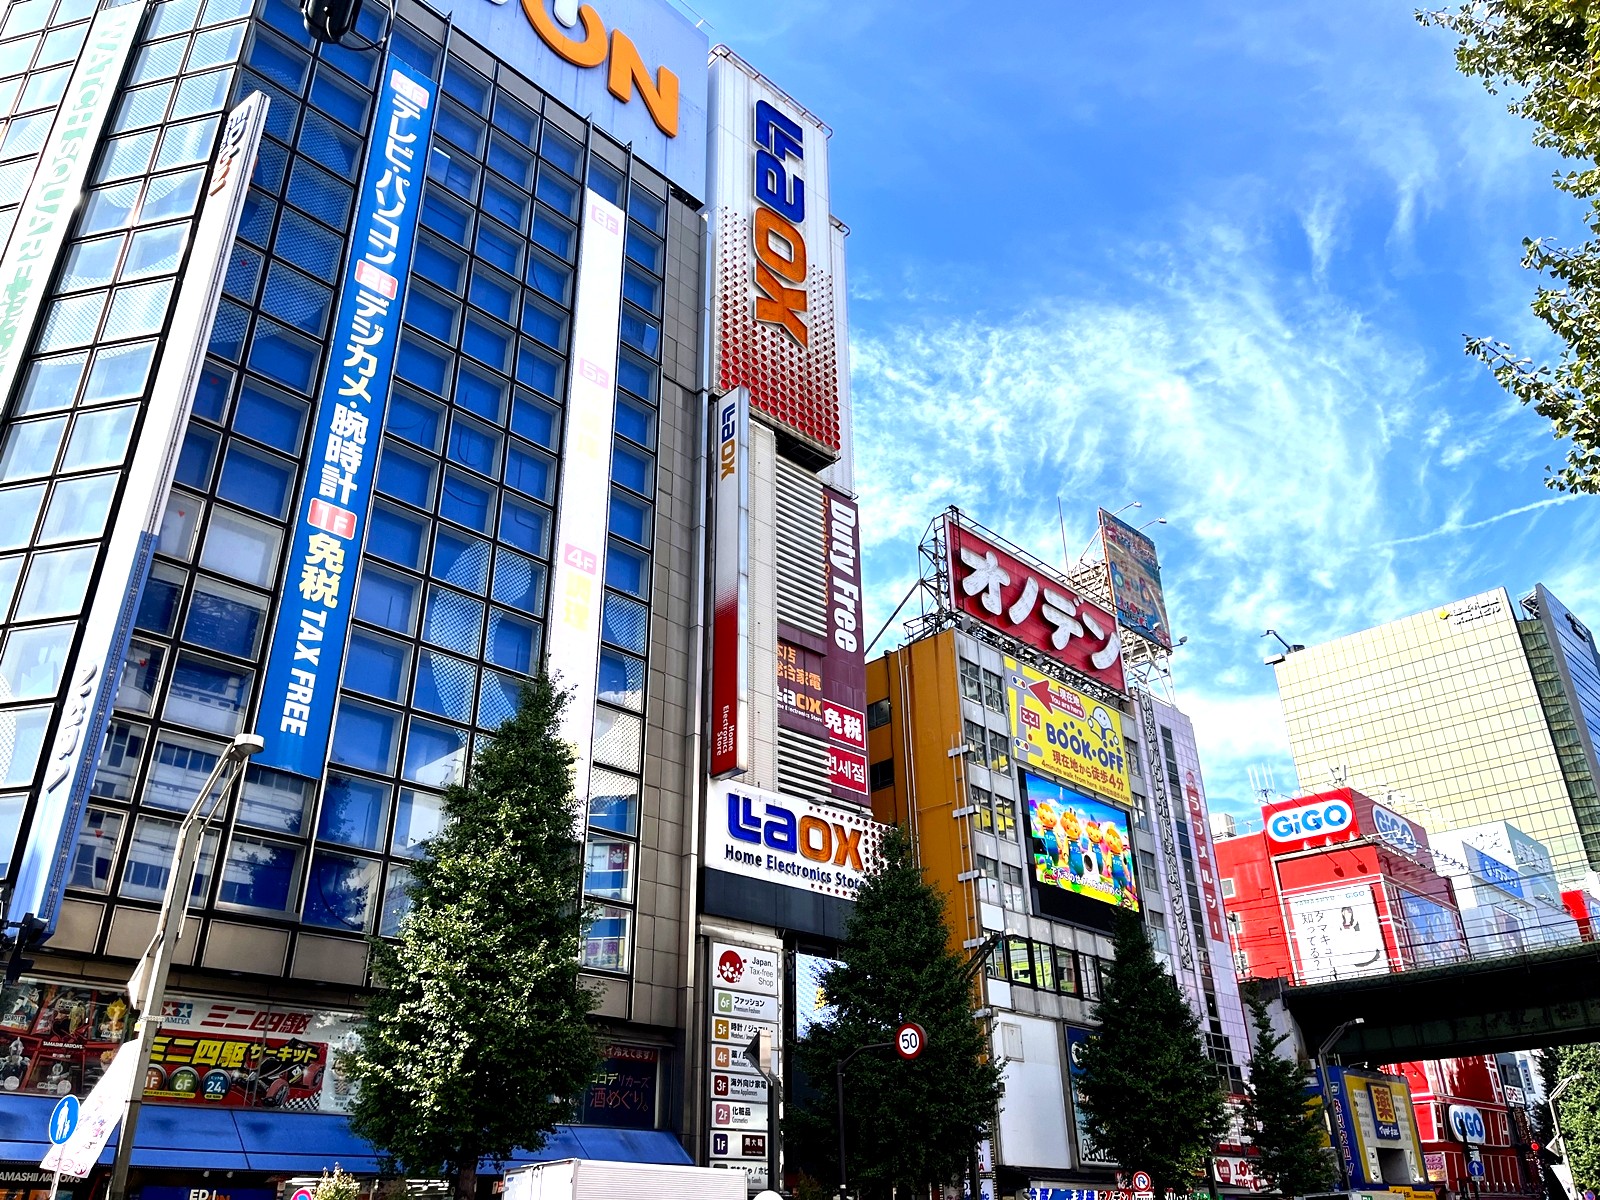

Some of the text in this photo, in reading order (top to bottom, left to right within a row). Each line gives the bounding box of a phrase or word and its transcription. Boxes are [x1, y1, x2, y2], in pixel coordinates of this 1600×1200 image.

[366, 92, 421, 265] テレビ・パソコン
[319, 290, 390, 505] デジカメ・腕時計
[314, 504, 350, 536] 1F
[299, 532, 346, 609] 免税
[566, 545, 595, 572] 4F
[830, 498, 859, 653] Duty Free
[960, 547, 1120, 670] オノデン
[280, 608, 327, 737] TAX FREE
[1021, 709, 1039, 726] ここ!
[1051, 695, 1084, 717] You are here
[722, 704, 730, 754] Electronics
[824, 707, 862, 742] 免税
[1052, 750, 1124, 792] 現在地から徒歩4分
[1271, 804, 1349, 835] GiGO
[725, 844, 762, 867] Home
[767, 854, 832, 884] Electronics
[1189, 795, 1219, 935] ラブメルシー
[750, 966, 774, 978] Tax-free
[758, 977, 774, 988] Shop
[720, 997, 730, 1008] 6F
[734, 996, 765, 1007] ファッション
[162, 1016, 190, 1025] AMIYA
[200, 1004, 314, 1035] ミニ四駆
[717, 1024, 727, 1035] 5F
[902, 1034, 918, 1049] 50
[717, 1052, 727, 1063] 4F
[175, 1079, 192, 1091] 6F
[716, 1079, 727, 1092] 3F
[731, 1077, 767, 1089] 海外向け家電
[718, 1108, 728, 1120] 2F
[732, 1106, 751, 1116] 化粧品
[1373, 1087, 1394, 1120] 薬
[716, 1138, 726, 1151] 1F
